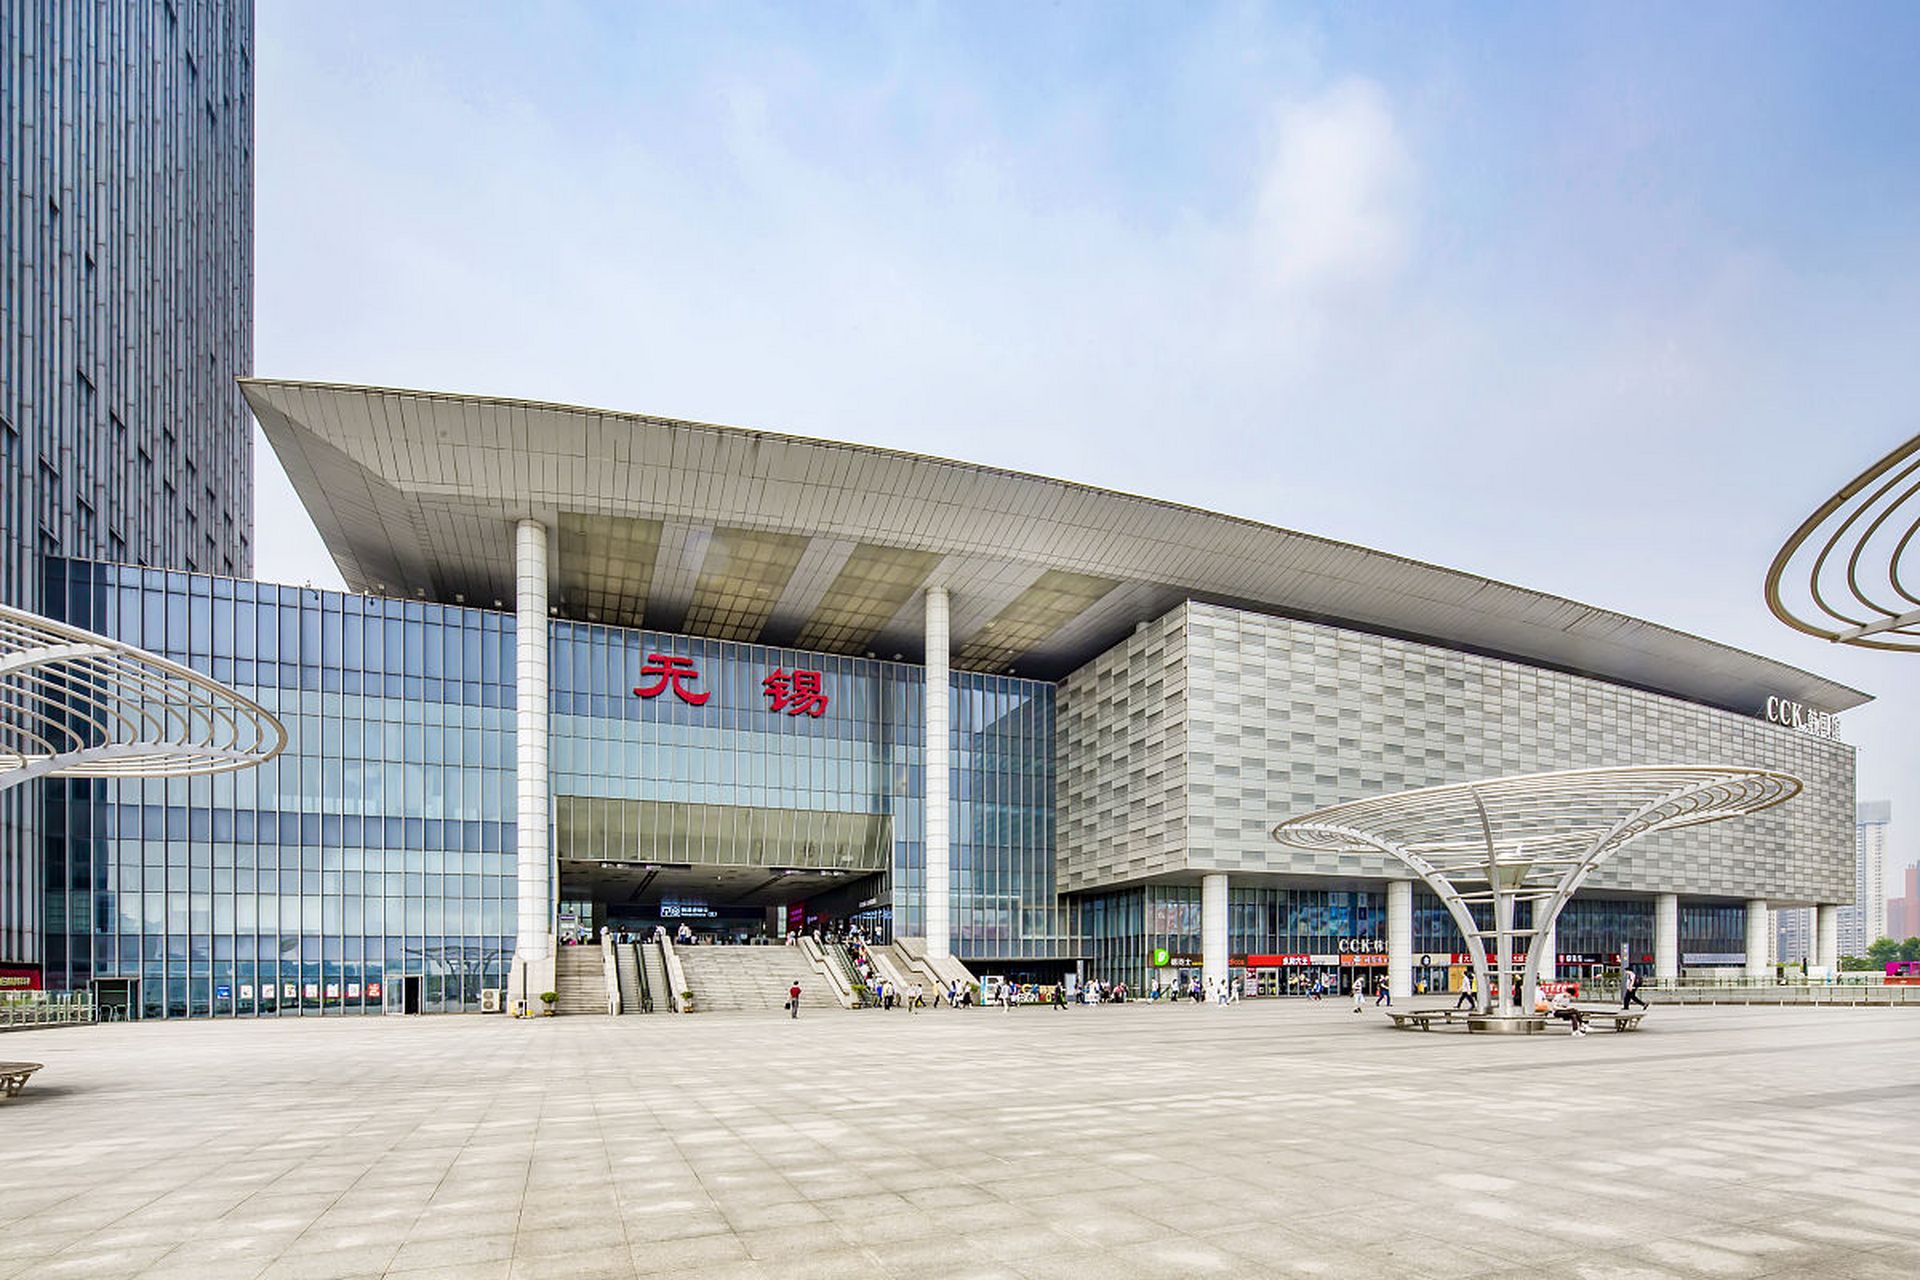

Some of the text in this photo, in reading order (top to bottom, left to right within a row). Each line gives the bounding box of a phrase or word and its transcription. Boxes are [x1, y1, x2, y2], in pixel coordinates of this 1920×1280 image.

[633, 653, 828, 718] 无锡
[1766, 695, 1803, 730] CCK
[1339, 938, 1370, 953] CCK
